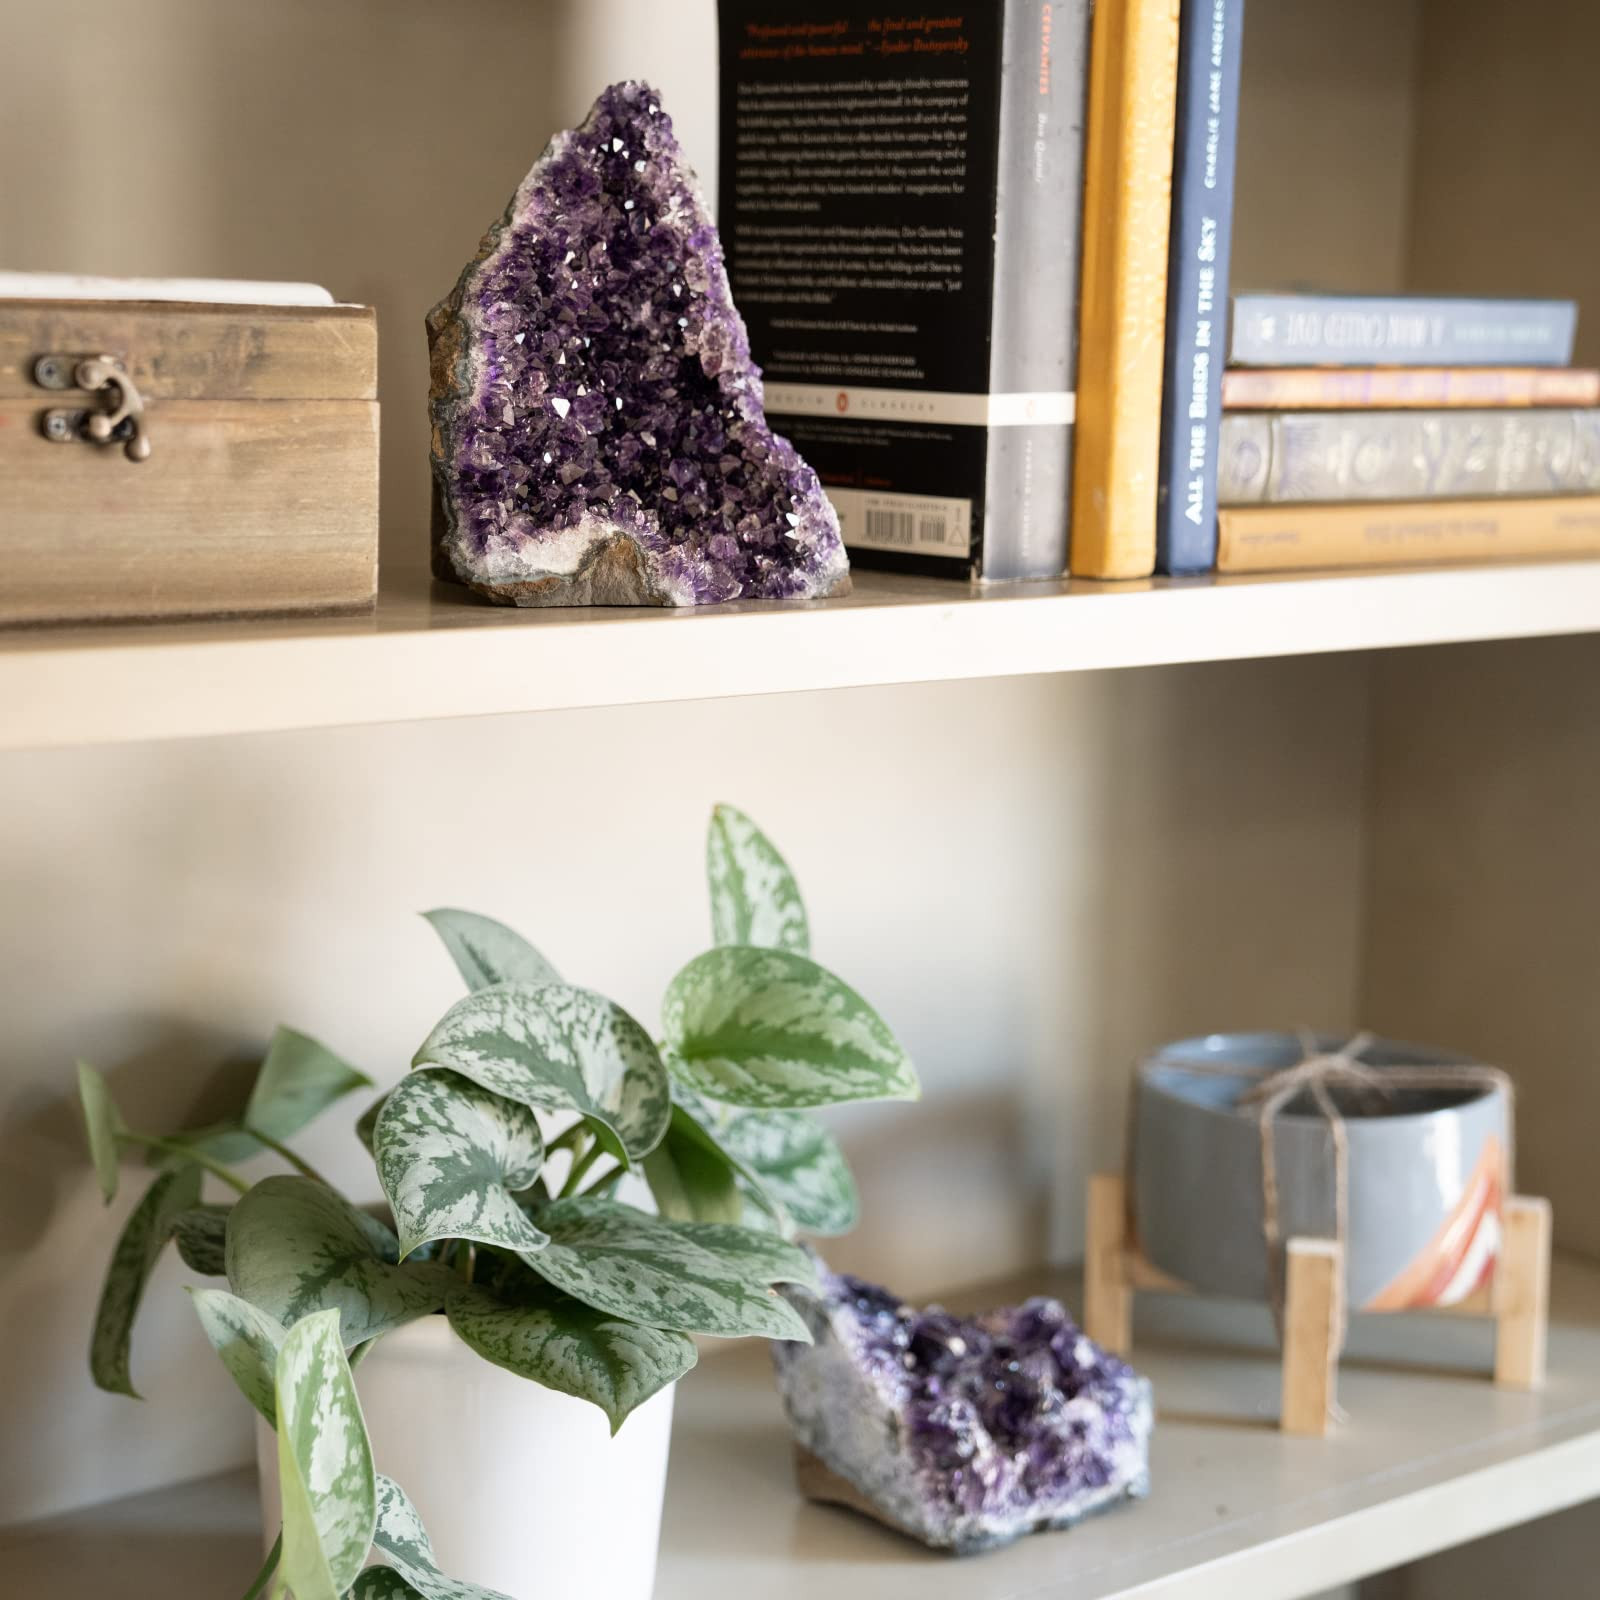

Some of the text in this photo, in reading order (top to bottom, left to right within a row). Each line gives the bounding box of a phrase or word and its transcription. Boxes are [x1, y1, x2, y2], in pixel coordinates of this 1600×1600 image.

[1040, 4, 1051, 95] CERVANTES
[1204, 0, 1225, 189] CHARLIE JANE ANDERS
[1185, 216, 1217, 525] ALL THE BIRDS IN THE SKY
